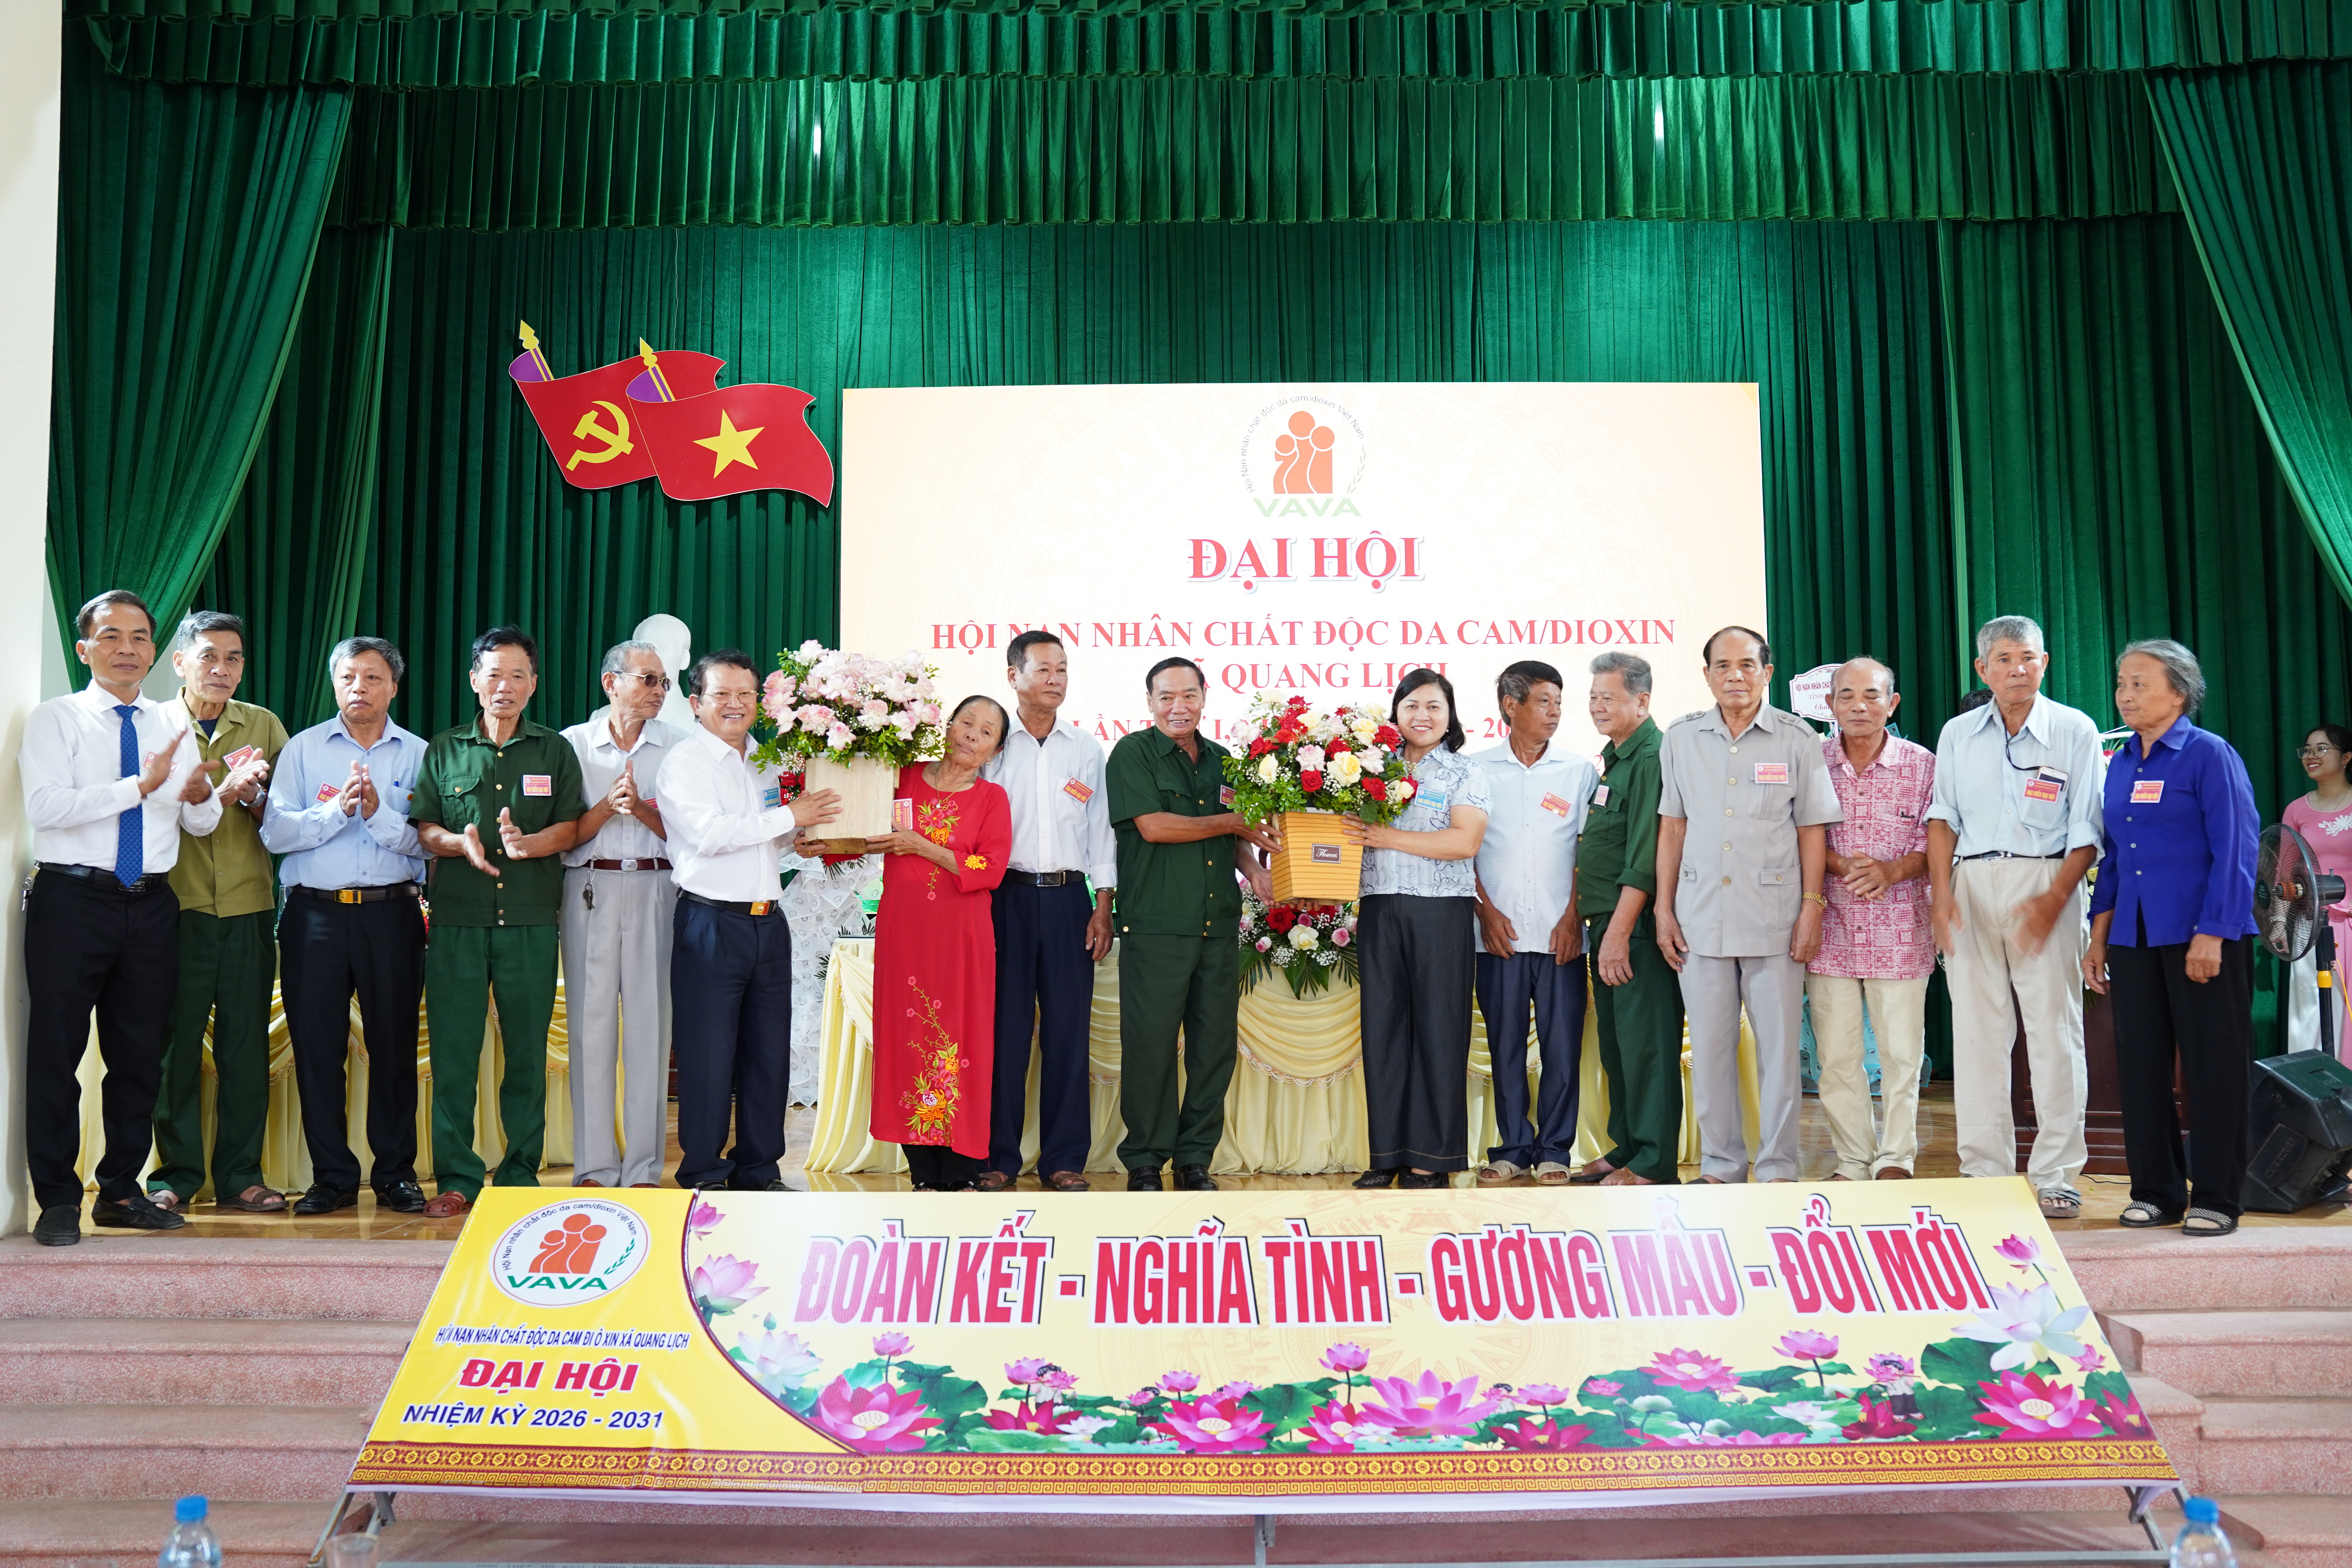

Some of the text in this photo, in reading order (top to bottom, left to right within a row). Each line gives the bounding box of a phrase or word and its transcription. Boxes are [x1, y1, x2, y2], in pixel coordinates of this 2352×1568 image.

[1240, 395, 1364, 493] Hội Nạn nhân chất độc da cam/dioxin Việt Nam
[1253, 498, 1362, 517] VAVA
[1187, 530, 1420, 590] ĐẠI HỘI
[931, 620, 997, 655] HỘI
[1092, 613, 1193, 647] NHÂN
[1204, 613, 1303, 646] CHẤT
[1312, 617, 1389, 652] ĐỘC
[1399, 621, 1448, 645] DA
[1457, 619, 1676, 645] CAM/DIOXIN
[1221, 662, 1351, 694] QUANG
[1802, 683, 1811, 692] NẠN
[1213, 719, 1230, 744] I,
[1316, 848, 1338, 858] Flowers
[541, 1208, 557, 1218] độc
[573, 1203, 617, 1214] cam/dioxin
[617, 1210, 629, 1221] Việt
[523, 1216, 541, 1229] chất
[626, 1220, 637, 1236] Nam
[509, 1230, 524, 1245] nhân
[502, 1245, 512, 1259] Nạn
[502, 1258, 511, 1271] Hội
[793, 1224, 942, 1324] ĐOÀN
[949, 1215, 1047, 1323] KẾT
[1060, 1280, 1077, 1296] -
[1094, 1225, 1252, 1325] NGHĨA
[1265, 1223, 1383, 1323] TÌNH
[1398, 1278, 1416, 1294] -
[1431, 1229, 1611, 1322] GƯƠNG
[1748, 1271, 1769, 1287] -
[1770, 1198, 1877, 1314] ĐỔI
[1866, 1211, 1991, 1311] MỚI
[507, 1276, 608, 1290] VAVA
[435, 1323, 690, 1351] HỘI NẠN NHÂN CHẤT ĐỘC DA CAM ĐI Ô XIN XÃ QUANG LỊCH
[459, 1358, 638, 1396] ĐẠI HỘI
[403, 1402, 485, 1428] NHIỆM
[491, 1403, 526, 1425] KỲ
[530, 1410, 588, 1427] 2026
[608, 1411, 663, 1428] 2031
